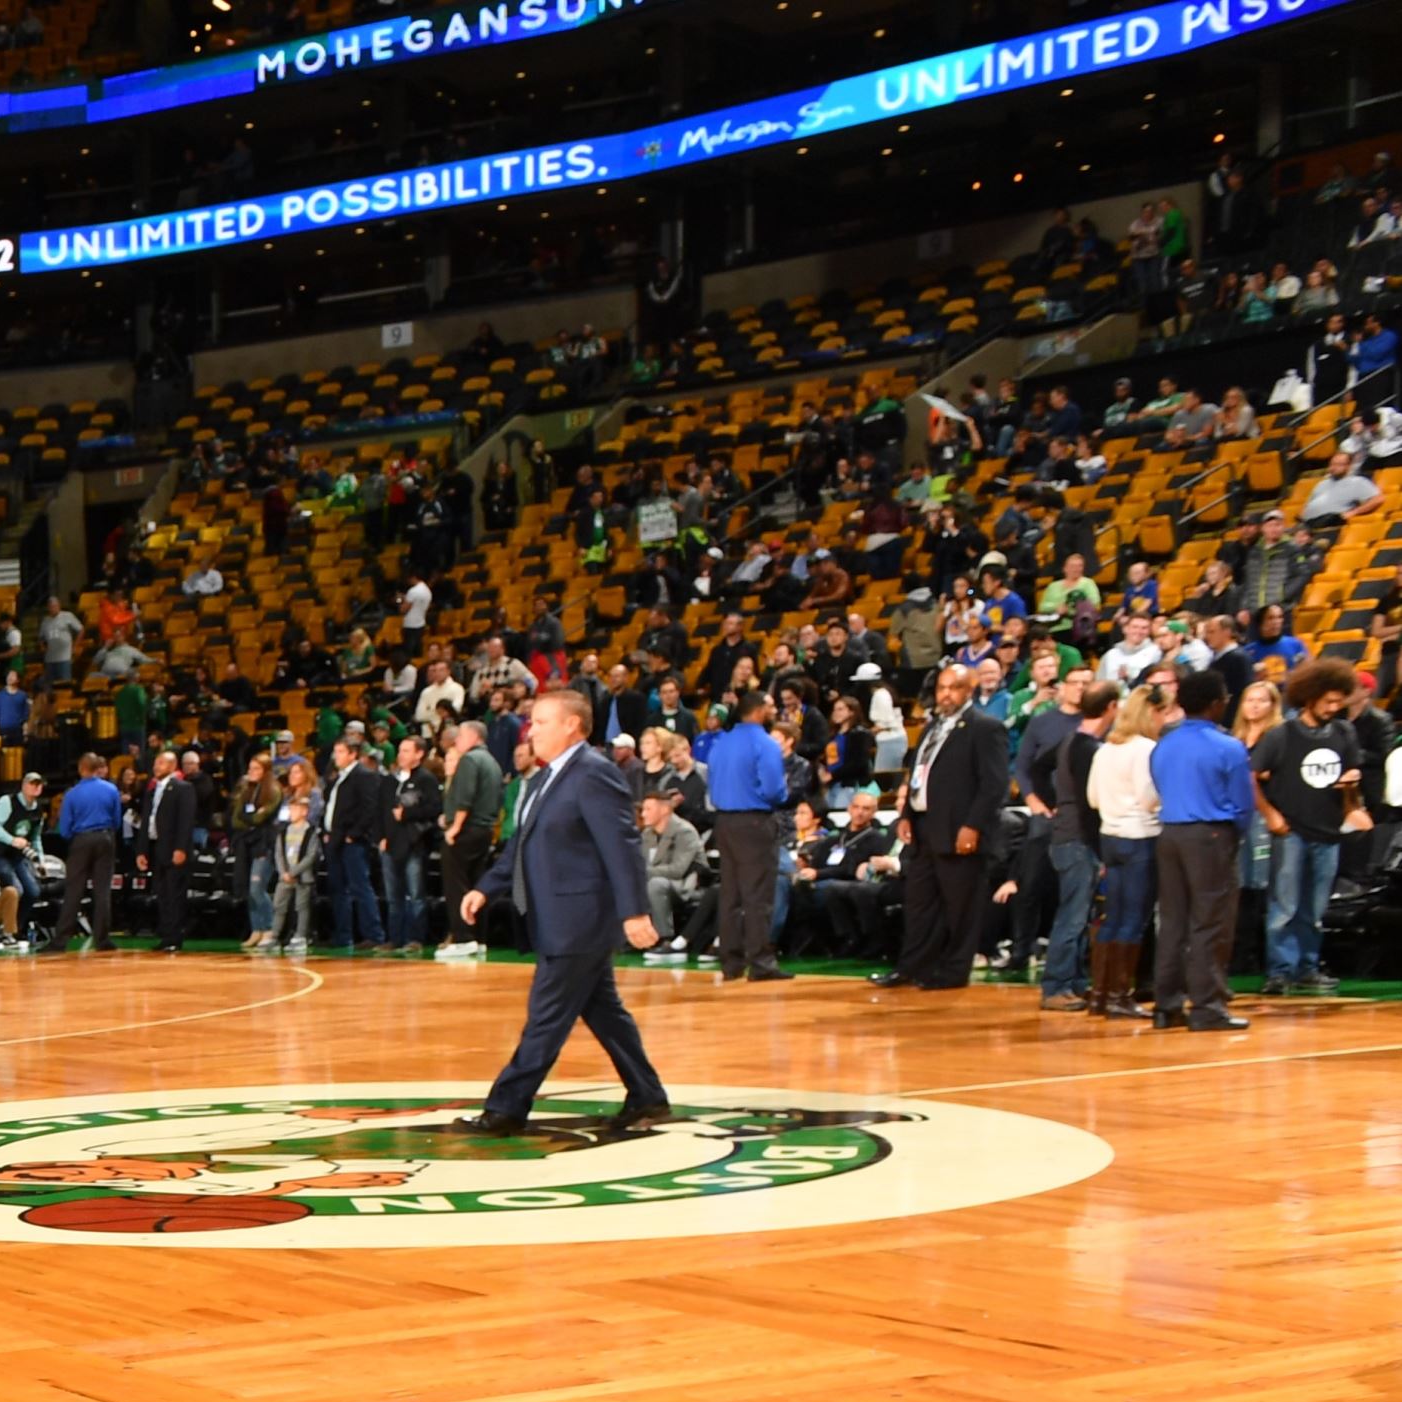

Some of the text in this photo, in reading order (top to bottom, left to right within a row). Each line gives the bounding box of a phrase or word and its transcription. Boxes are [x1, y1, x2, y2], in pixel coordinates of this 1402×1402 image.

[876, 16, 1161, 112] UNLIMITED
[39, 144, 608, 267] UNLIMITED POSSIBILITIES.
[391, 326, 402, 344] 9
[1300, 760, 1342, 777] TNT
[348, 1144, 859, 1213] BOSTON
